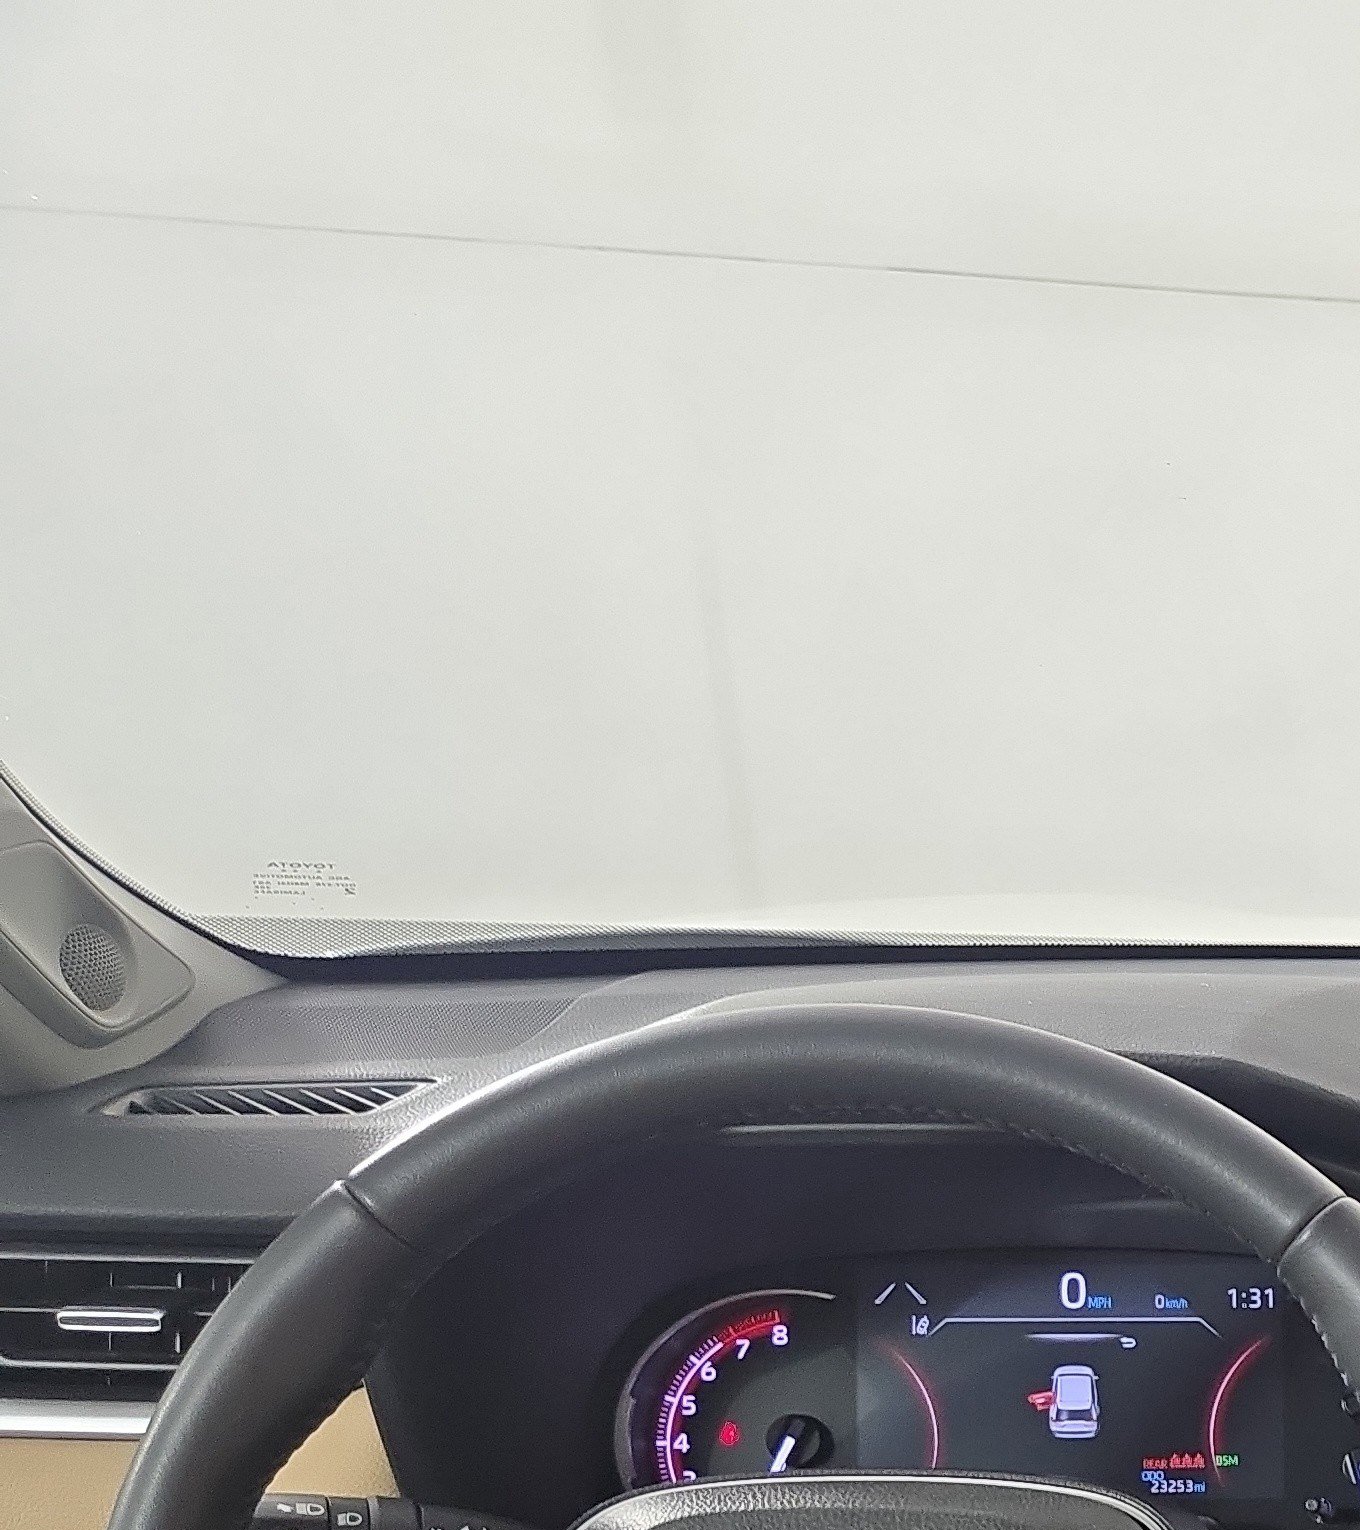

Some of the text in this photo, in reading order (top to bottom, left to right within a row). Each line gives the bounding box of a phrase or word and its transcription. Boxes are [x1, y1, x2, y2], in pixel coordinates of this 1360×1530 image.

[1060, 1271, 1113, 1310] 0 MPH
[1226, 1286, 1276, 1310] 1:31
[1154, 1293, 1165, 1310] 0
[771, 1325, 789, 1346] 8
[736, 1339, 751, 1360] 7
[700, 1361, 718, 1382] 6
[681, 1394, 697, 1416] 5
[673, 1433, 691, 1454] 4
[1142, 1470, 1165, 1482] ODO
[1150, 1479, 1194, 1494] 23253
